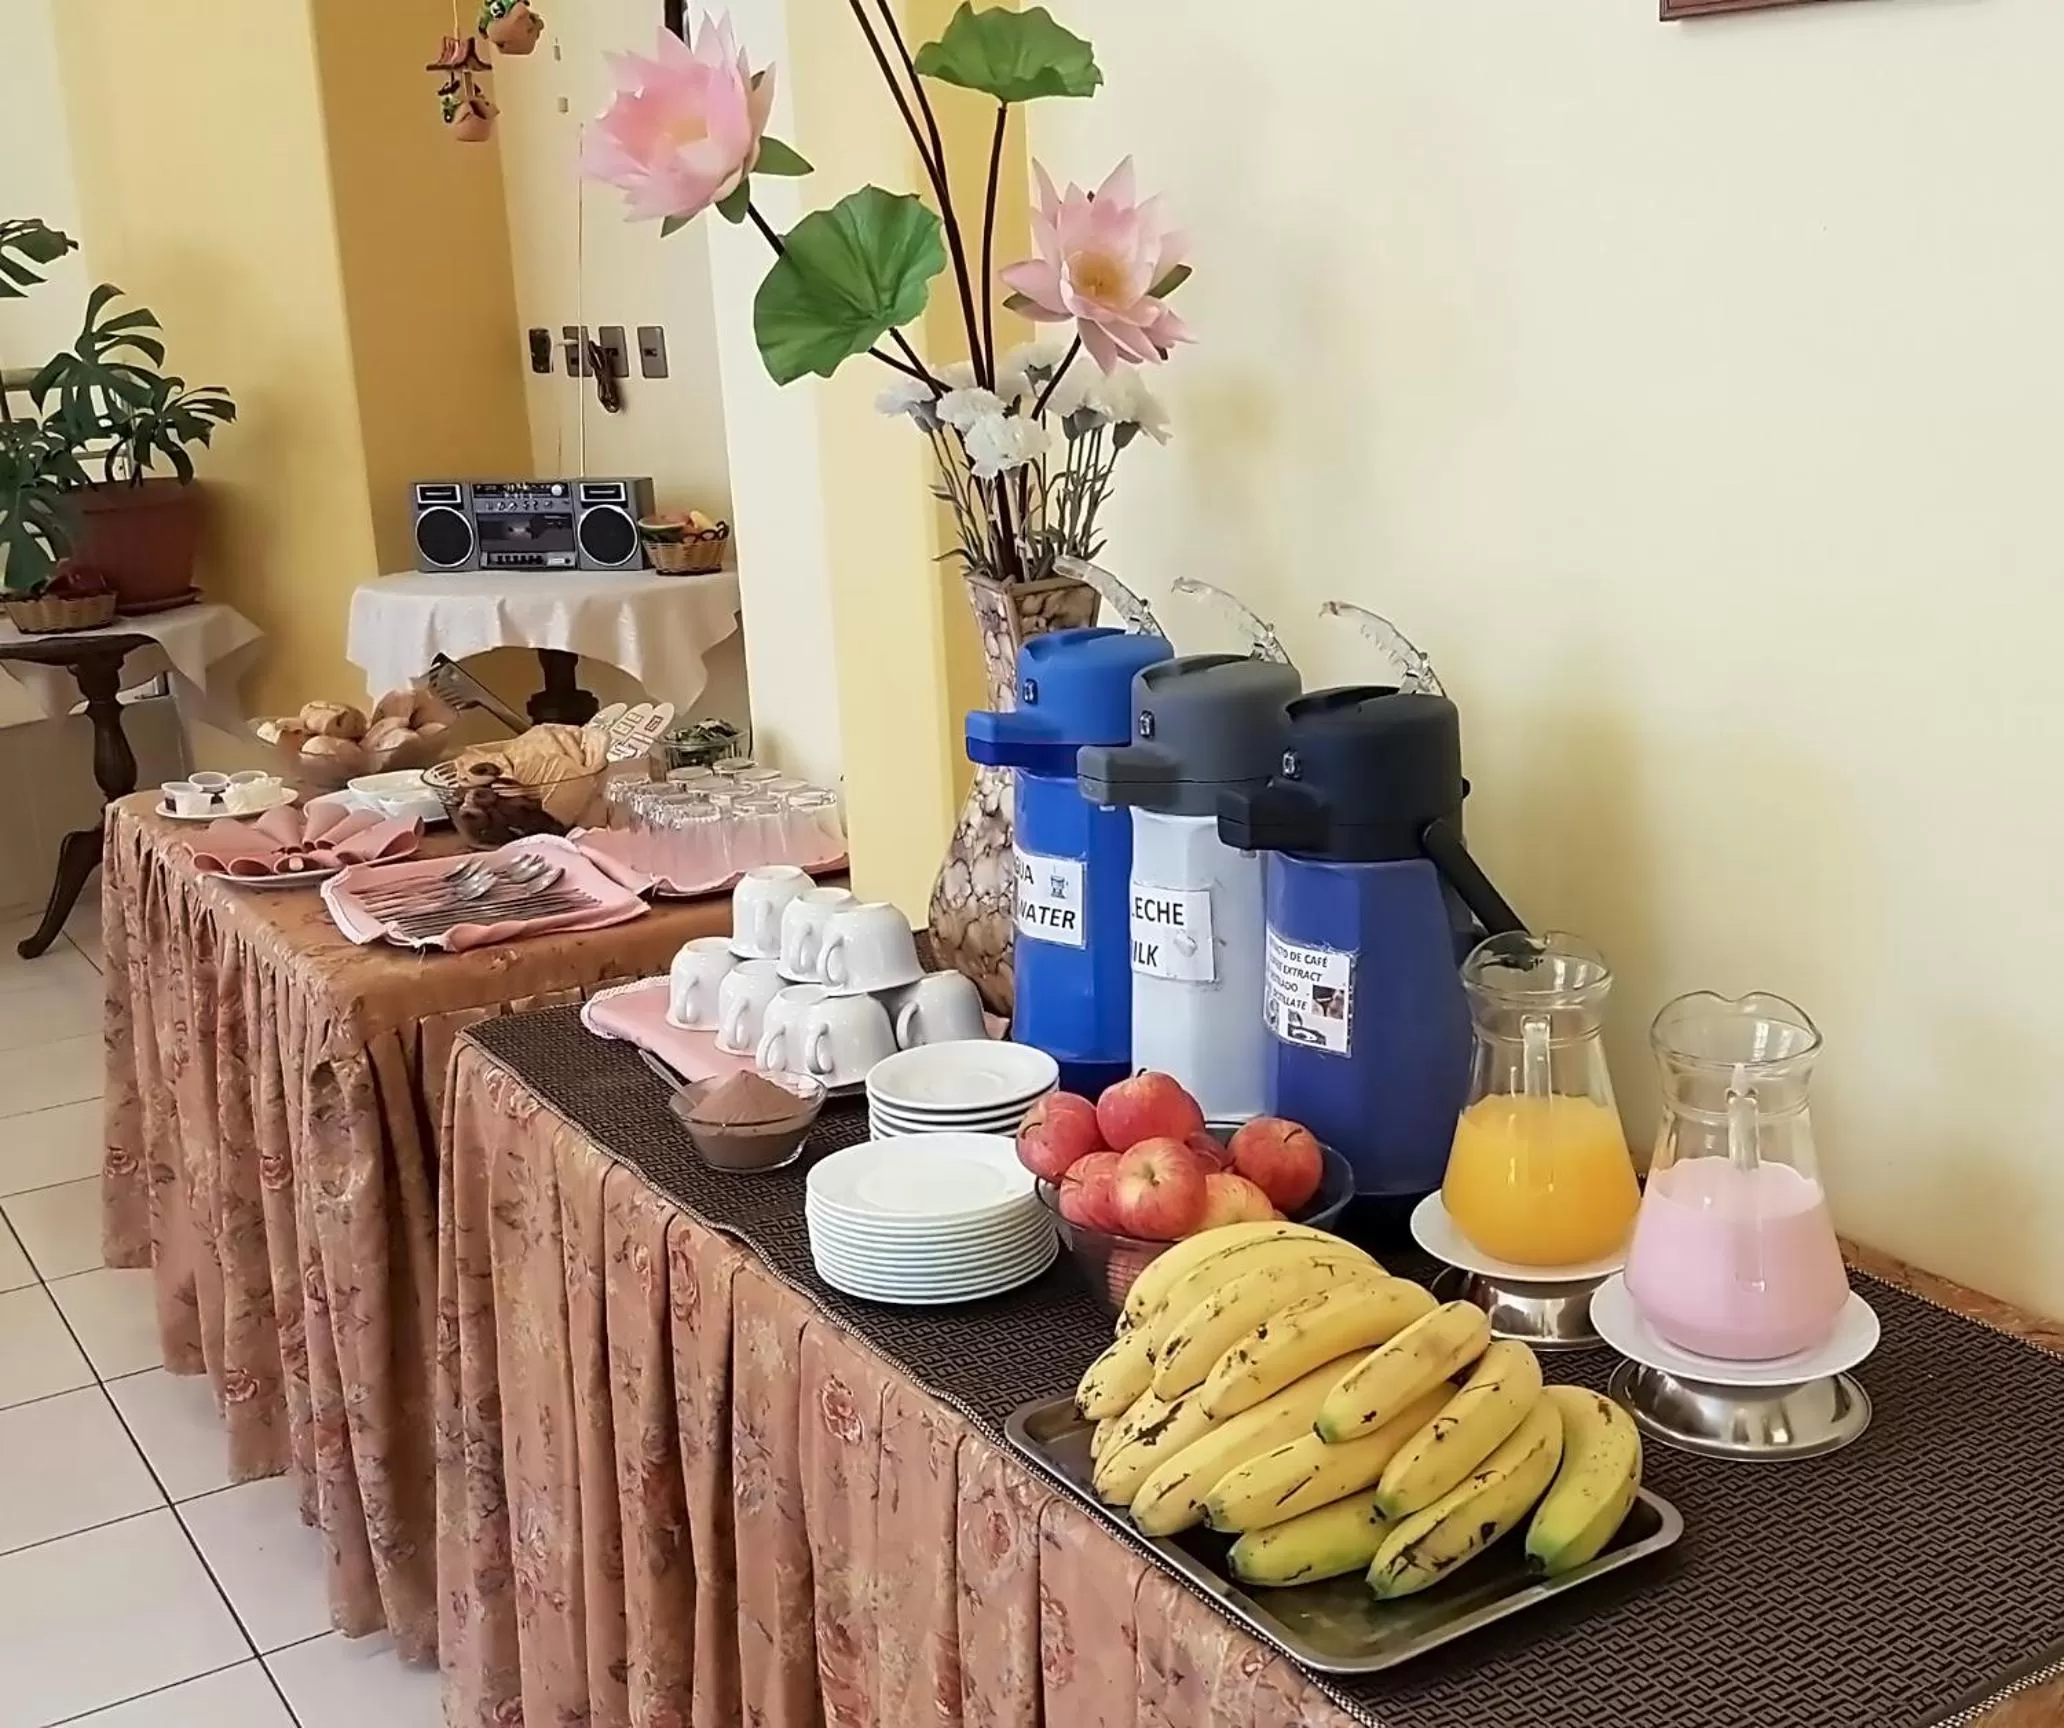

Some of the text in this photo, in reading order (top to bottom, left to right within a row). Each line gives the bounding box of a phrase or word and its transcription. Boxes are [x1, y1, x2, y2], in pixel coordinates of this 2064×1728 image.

[1132, 896, 1185, 926] ECHE
[1133, 940, 1159, 967] ILK
[1290, 951, 1302, 963] DE
